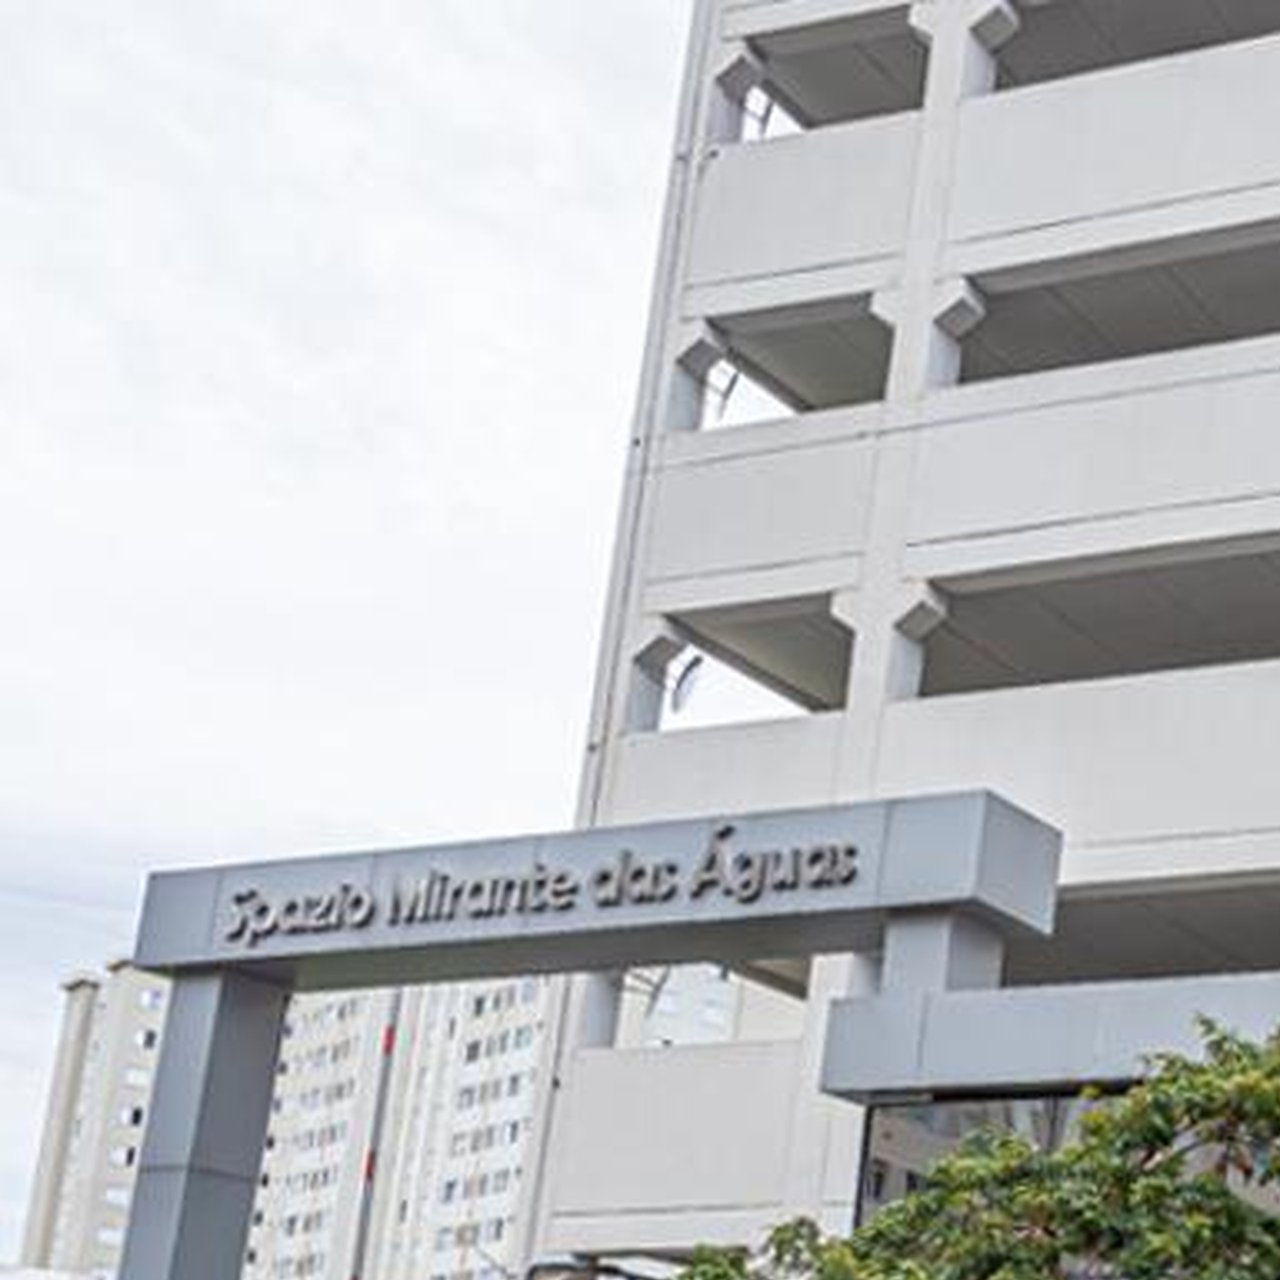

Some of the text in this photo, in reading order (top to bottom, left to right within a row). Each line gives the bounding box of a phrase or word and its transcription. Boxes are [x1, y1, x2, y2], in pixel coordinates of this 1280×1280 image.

[225, 825, 859, 947] Spazio Mirante das Águas
